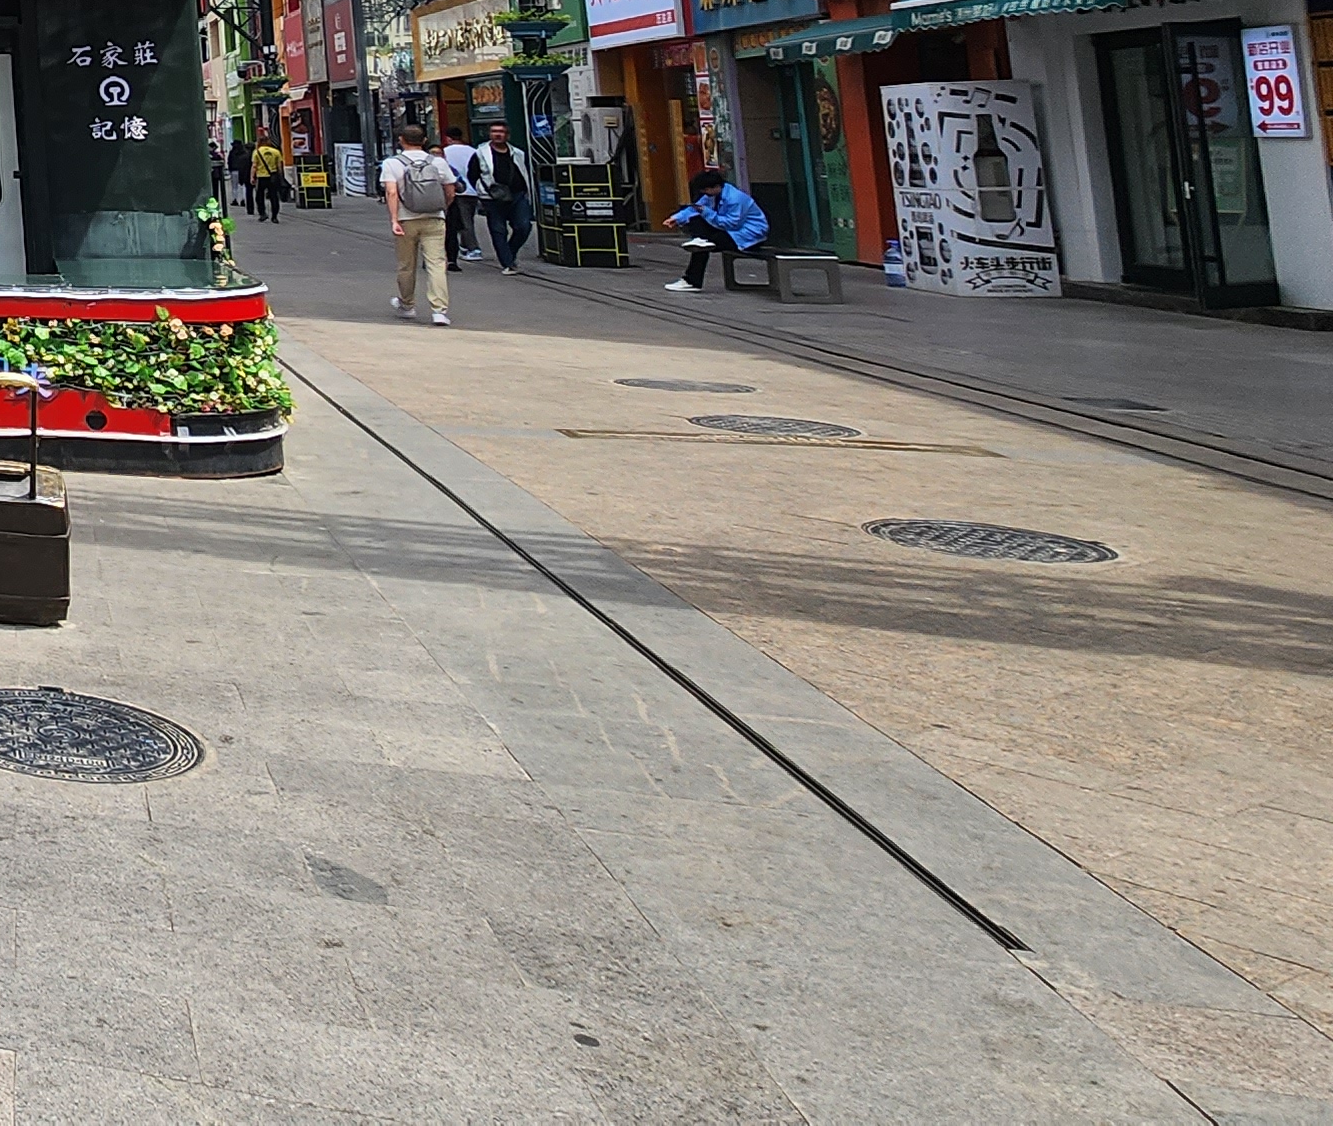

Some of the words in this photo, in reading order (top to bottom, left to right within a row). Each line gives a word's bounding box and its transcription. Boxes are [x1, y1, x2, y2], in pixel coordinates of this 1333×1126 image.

[1255, 74, 1295, 117] 99
[959, 255, 1053, 271] 火车头步行街
